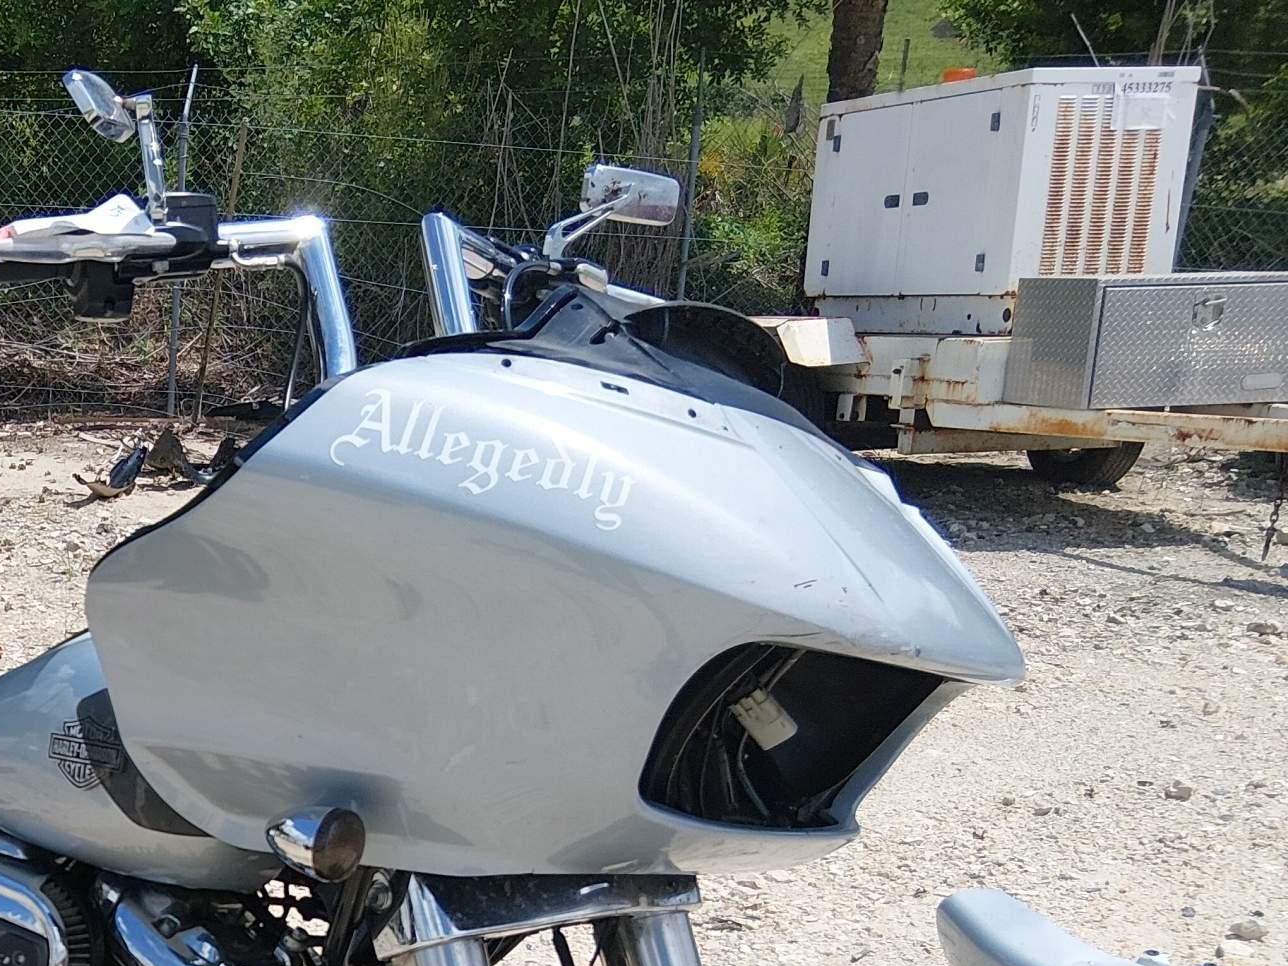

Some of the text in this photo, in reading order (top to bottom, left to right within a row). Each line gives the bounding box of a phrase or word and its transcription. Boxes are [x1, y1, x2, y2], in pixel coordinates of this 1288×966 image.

[330, 388, 635, 531] Allegedly
[53, 739, 117, 763] HARLEY-D
[65, 761, 100, 782] CYCLE
